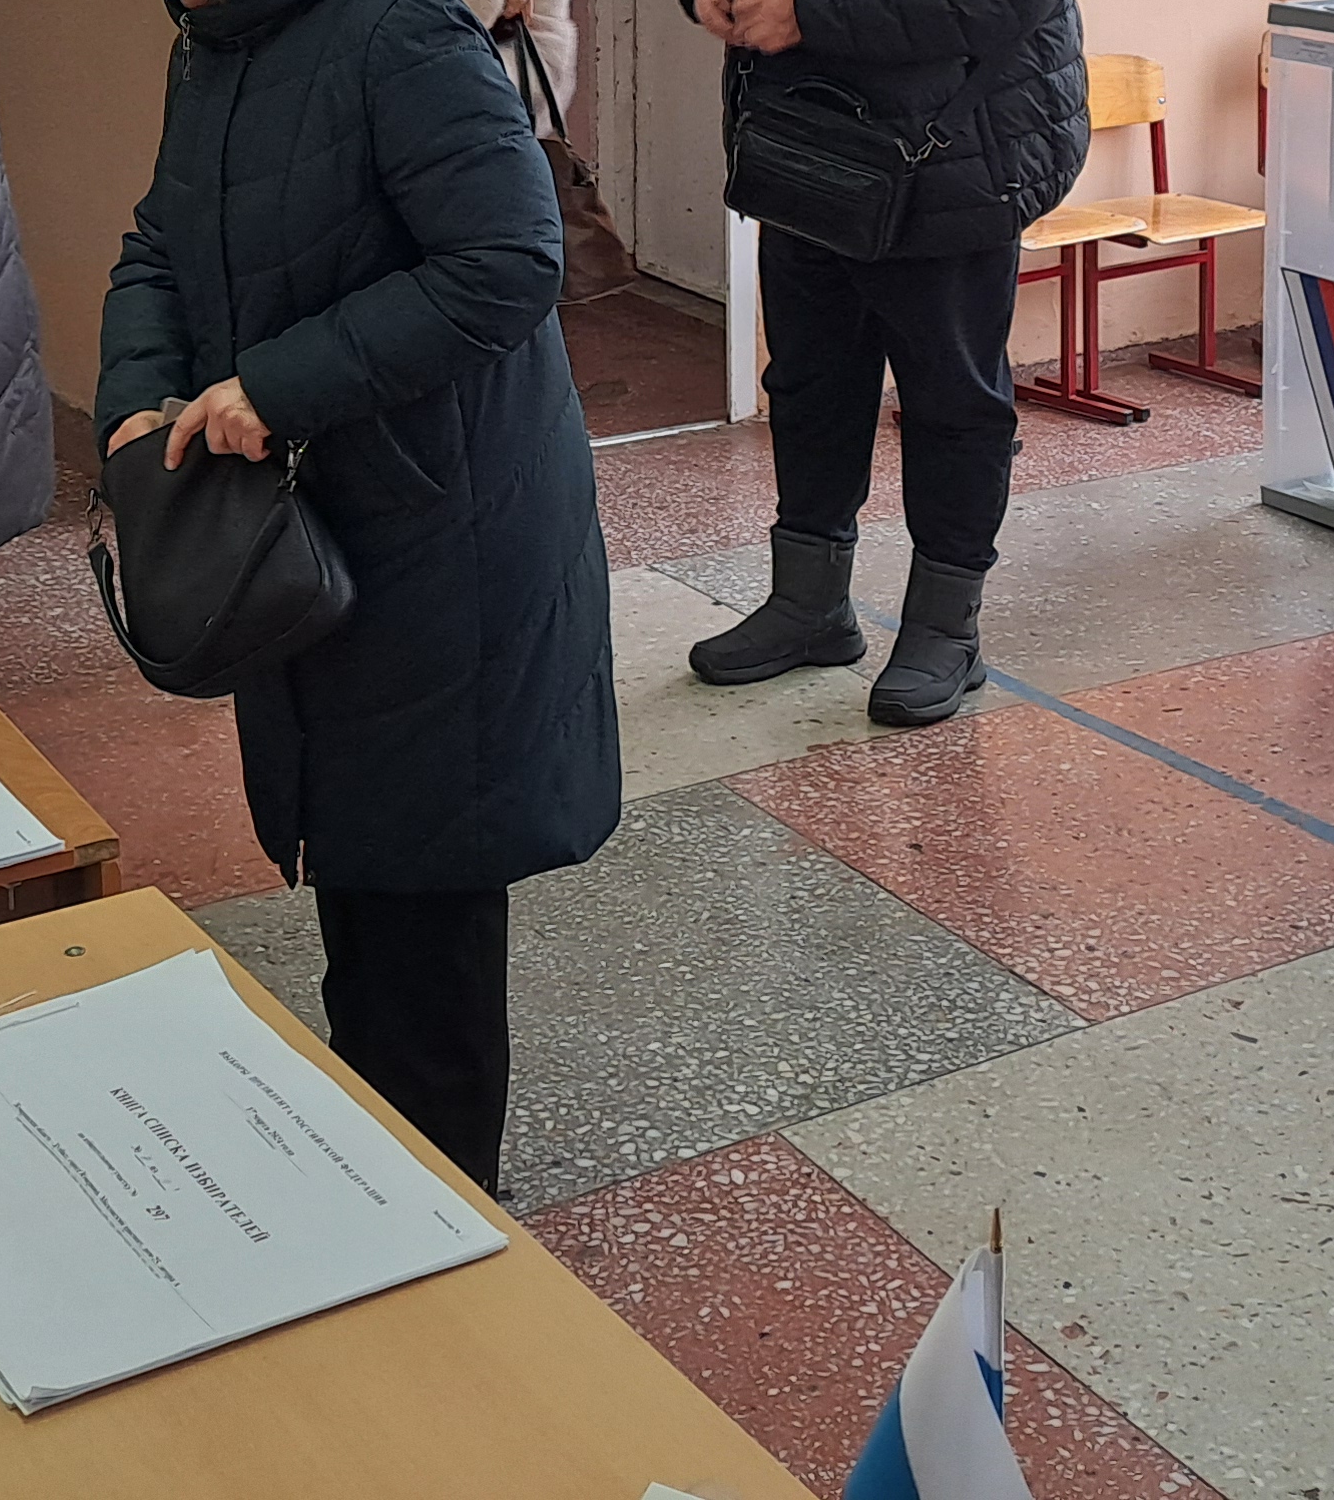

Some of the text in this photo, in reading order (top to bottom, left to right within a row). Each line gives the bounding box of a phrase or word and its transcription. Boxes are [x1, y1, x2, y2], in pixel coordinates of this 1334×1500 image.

[110, 1087, 271, 1243] КНИГА СПИСКА ИЗБИРАТЕЛЕЙ
[146, 1205, 171, 1221] 297
